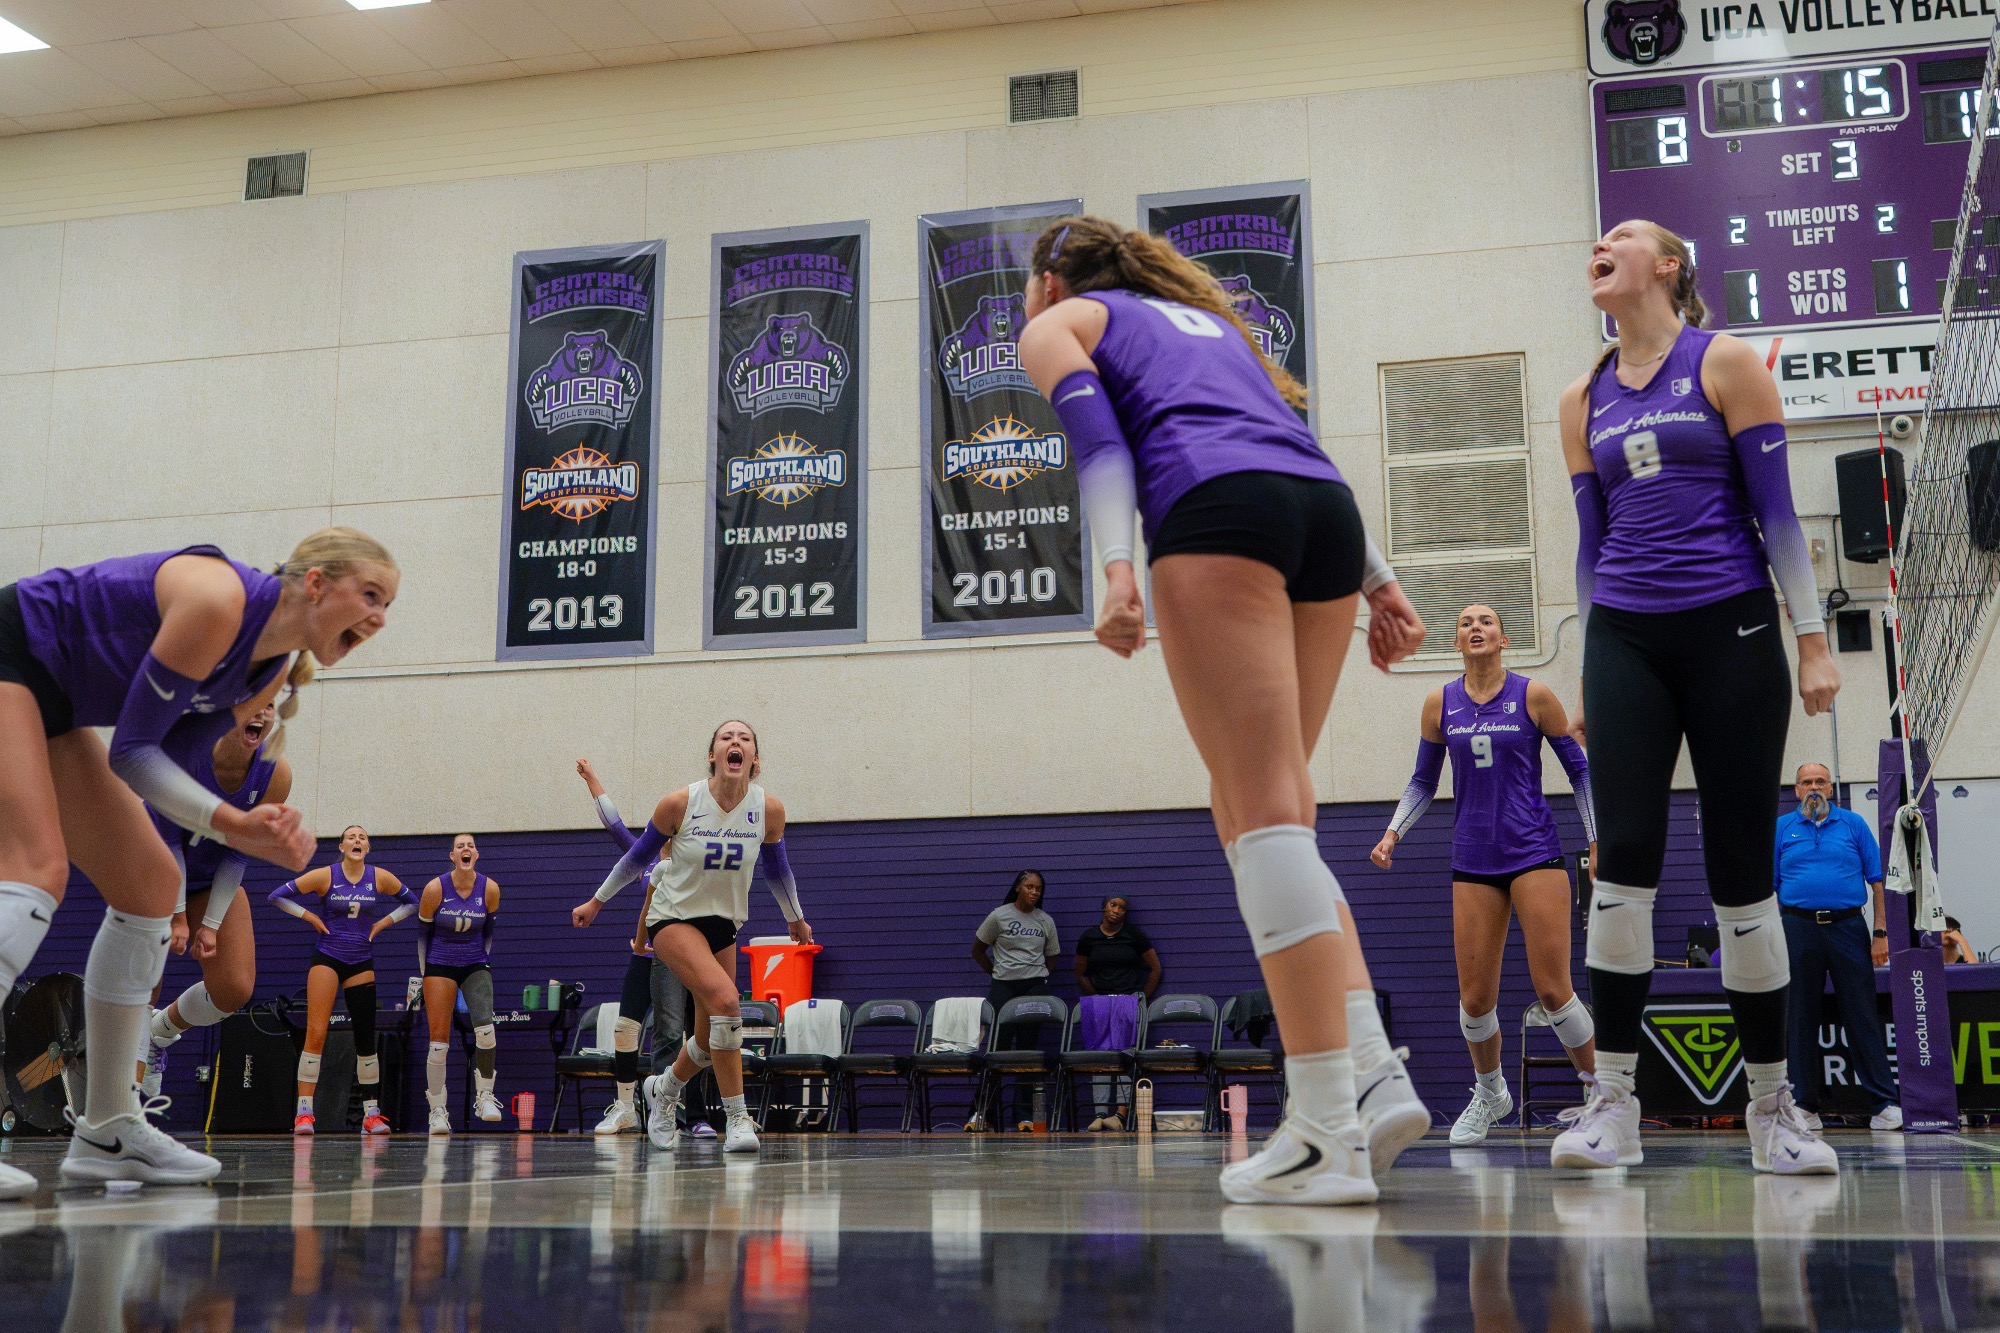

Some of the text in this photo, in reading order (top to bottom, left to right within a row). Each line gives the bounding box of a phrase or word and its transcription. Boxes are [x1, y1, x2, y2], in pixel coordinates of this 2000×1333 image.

[1701, 0, 1997, 42] UCA VOLLEYBALL
[1657, 116, 1688, 165] 8
[1839, 124, 1899, 136] FAIR-PLAY
[1781, 152, 1822, 176] SET
[1831, 140, 1858, 179] 3
[1164, 214, 1287, 243] CENTRAL
[1765, 204, 1860, 227] TIMEOUTS
[1877, 206, 1895, 232] 2
[1729, 217, 1746, 244] 2
[1792, 226, 1836, 246] LEFT
[1174, 231, 1295, 257] RKANSAS
[734, 253, 847, 283] CENTRAL
[1787, 267, 1847, 292] SETS
[535, 271, 643, 300] CENTRAL
[727, 269, 854, 303] ARKANSAS
[1748, 272, 1760, 320] 1
[1897, 261, 1909, 309] 1
[527, 288, 648, 320] ARKANSAS
[1789, 291, 1848, 316] WON
[960, 342, 1026, 382] UC
[747, 360, 830, 400] UCA
[544, 376, 624, 415] UCA
[758, 392, 818, 407] VOLLEYBALL
[1780, 393, 1831, 407] ICK
[554, 408, 612, 422] VOLLEYBALL
[1590, 410, 1710, 449] Central Arkansas
[946, 436, 1062, 475] SOUTHLAND
[965, 459, 1043, 473] CONFERENCE
[1622, 429, 1663, 481] 8
[524, 464, 637, 503] SOUTHLAND
[731, 453, 842, 490] SOUTHLAND
[749, 474, 823, 488] CONFERENCE
[543, 487, 616, 500] CONFERENCE
[940, 505, 1070, 531] CHAMPIONS
[724, 521, 848, 546] CHAMPIONS
[983, 531, 1027, 551] 15-1
[518, 535, 638, 559] CHAMPIONS
[764, 546, 808, 566] 15-3
[557, 559, 597, 579] 18-0
[952, 566, 1057, 607] 2010
[527, 594, 623, 632] 2013
[734, 581, 835, 620] 2012
[1447, 722, 1521, 736] Central Arkansas
[1470, 734, 1494, 769] 9
[691, 826, 758, 839] Central Arkansas
[703, 842, 744, 871] 22
[347, 901, 361, 919] 3
[454, 916, 473, 933] 11
[1005, 920, 1045, 938] Bears
[1911, 969, 1932, 1067] sports imports
